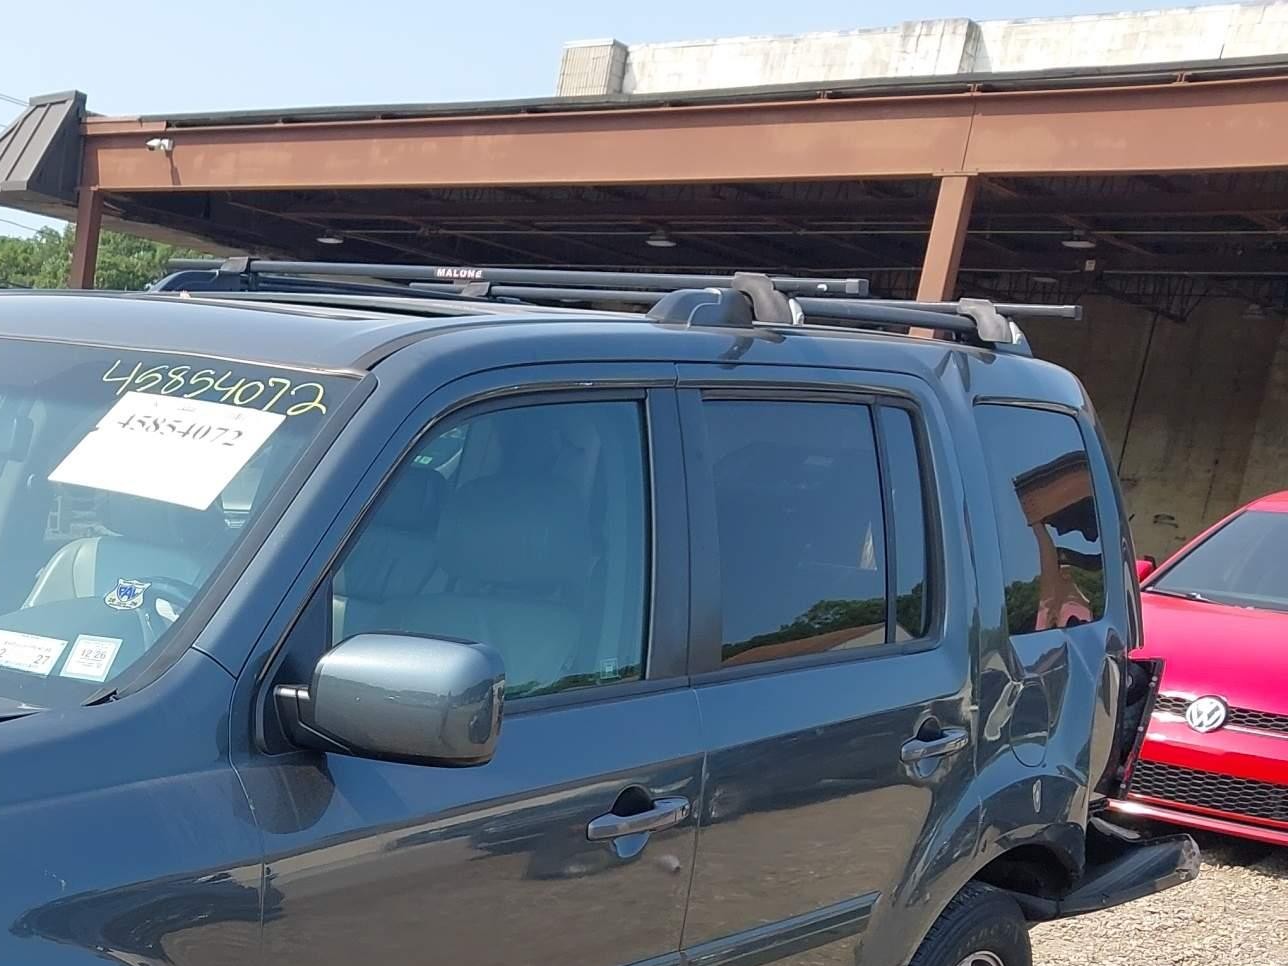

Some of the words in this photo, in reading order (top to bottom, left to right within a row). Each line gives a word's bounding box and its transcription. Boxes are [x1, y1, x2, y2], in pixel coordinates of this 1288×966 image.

[436, 268, 482, 278] MALONE
[102, 359, 327, 417] 45854072
[117, 413, 244, 447] 45854072
[33, 654, 51, 665] 27
